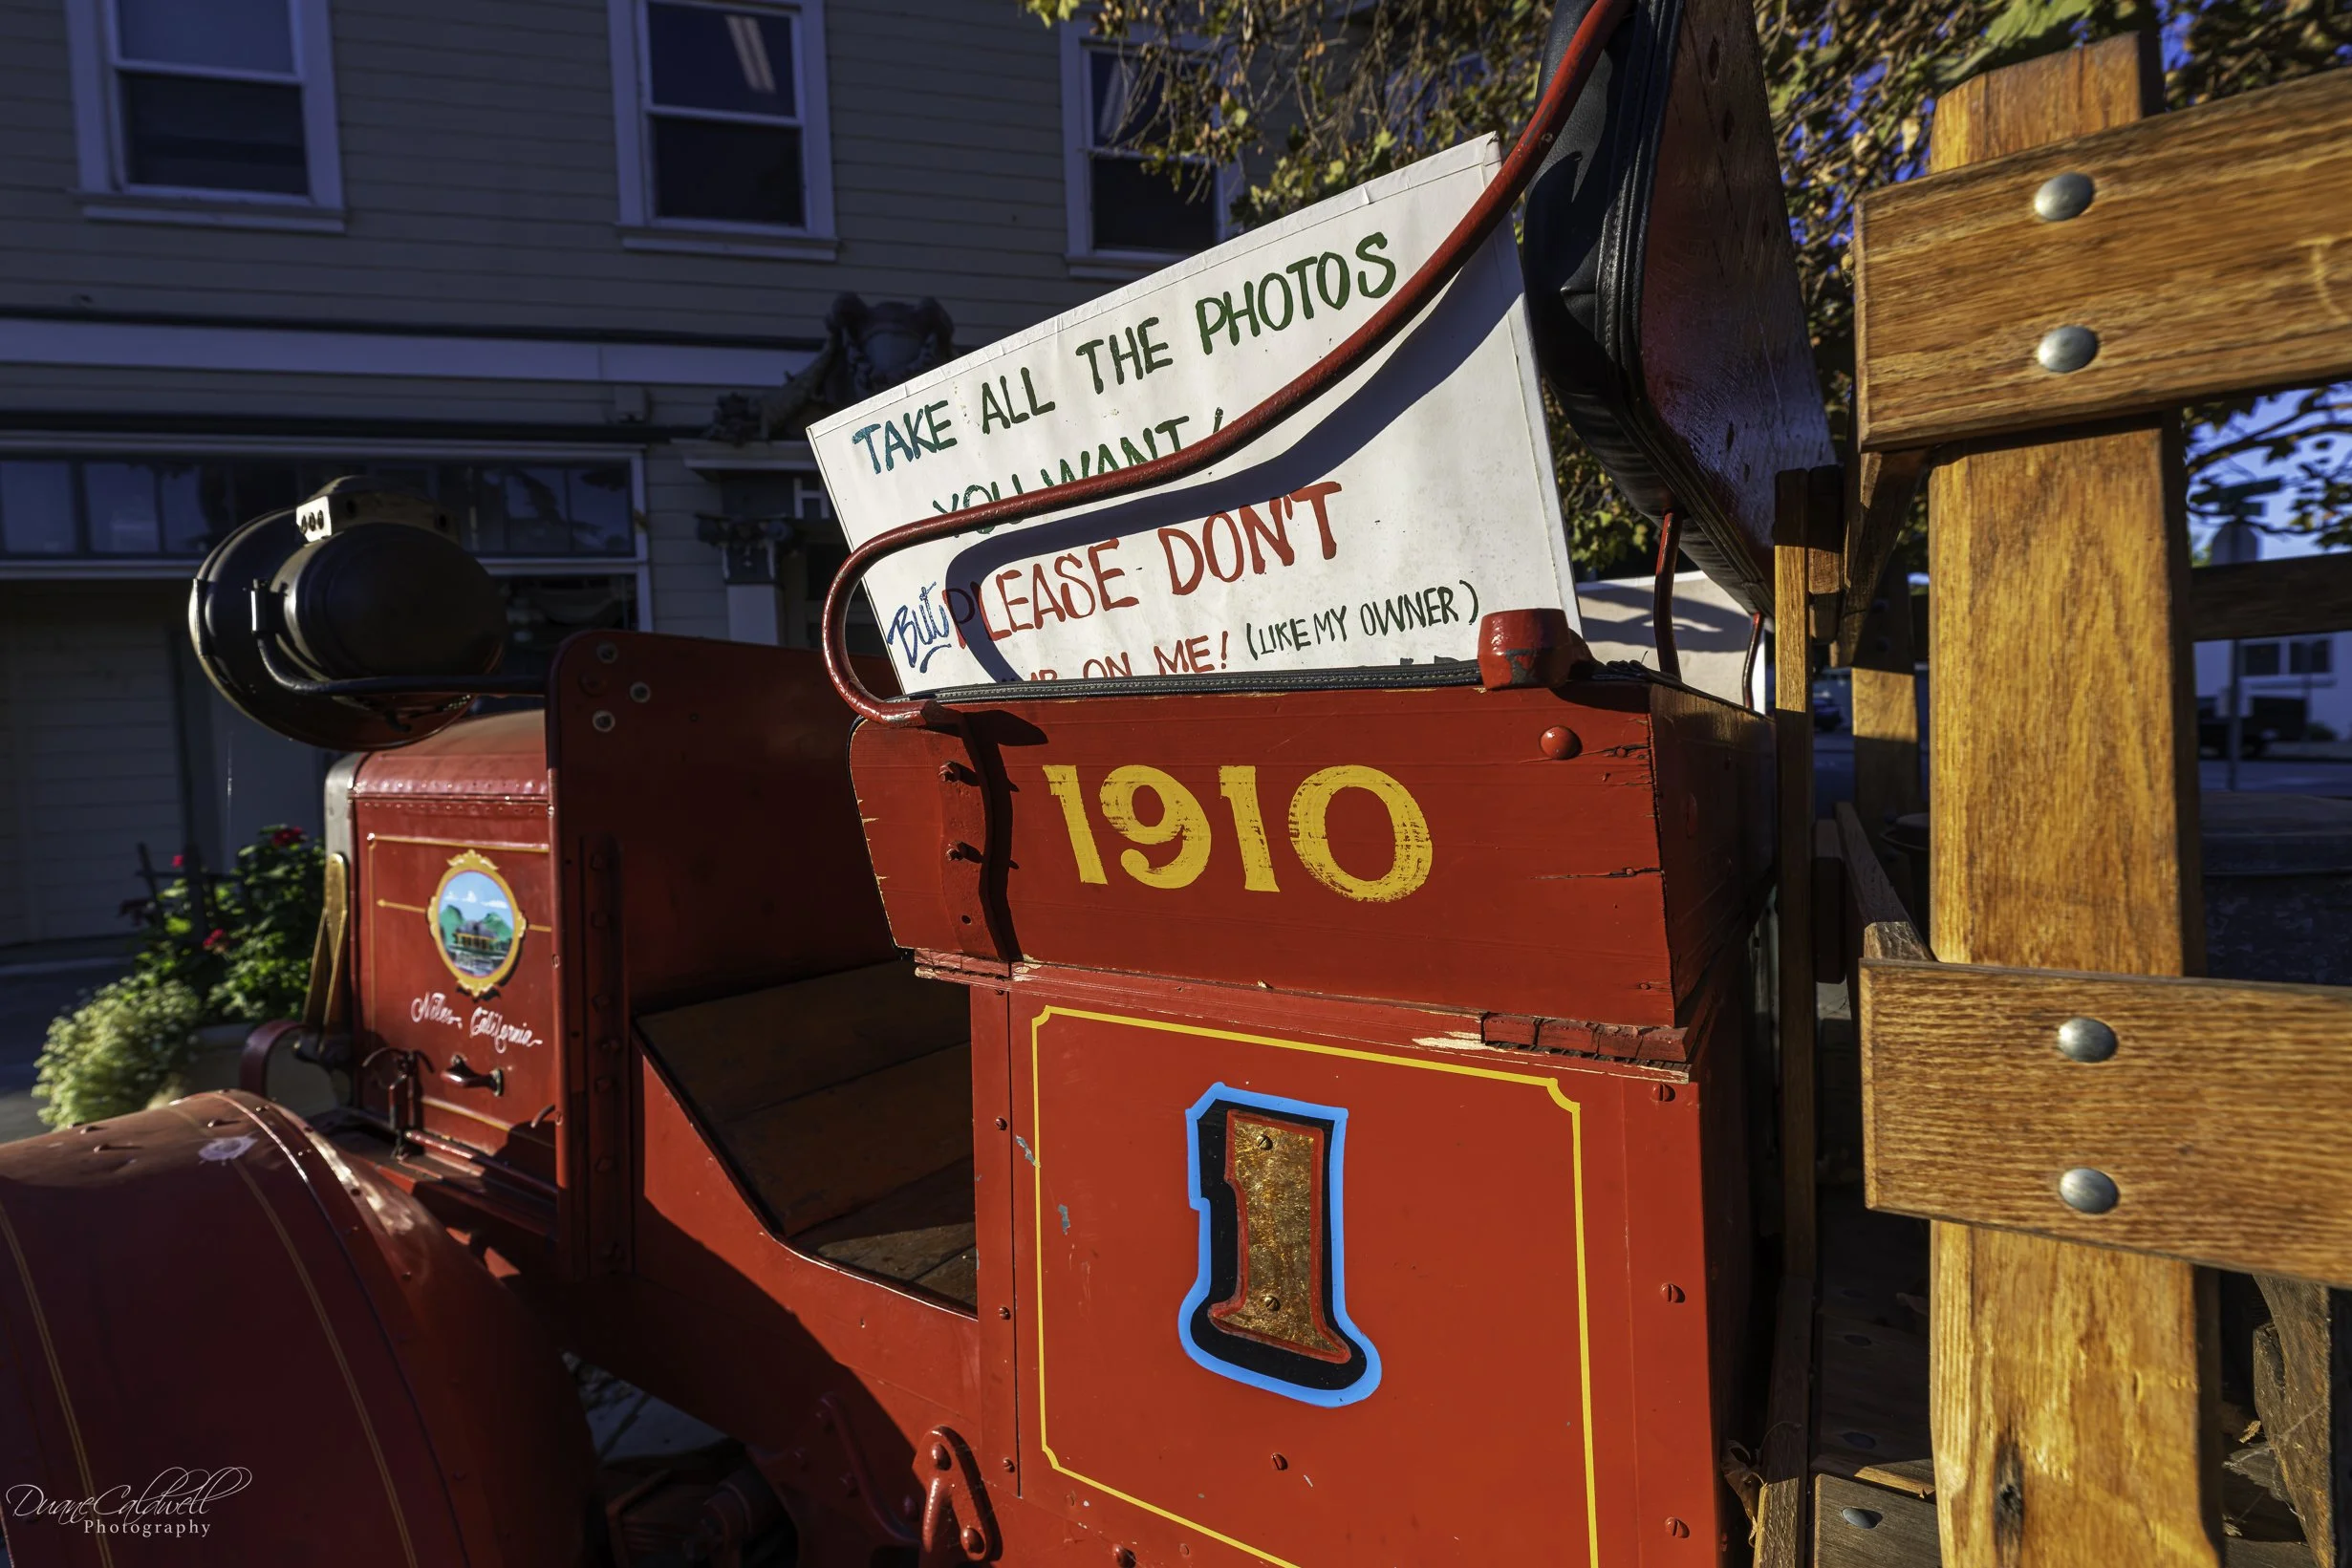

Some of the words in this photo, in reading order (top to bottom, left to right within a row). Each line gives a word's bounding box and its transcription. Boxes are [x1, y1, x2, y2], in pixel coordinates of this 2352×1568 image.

[852, 400, 958, 475] TAKE
[981, 367, 1056, 435] ALL
[1075, 317, 1174, 395] THE
[1195, 231, 1397, 355] PHOTOS
[941, 537, 1140, 650] PLEASE
[1157, 481, 1342, 596] DON'T
[1154, 631, 1229, 677] ME!
[1245, 617, 1312, 661] (LIKE
[1313, 605, 1349, 645] MY
[1042, 764, 1434, 903] 1910
[469, 1006, 544, 1054] California
